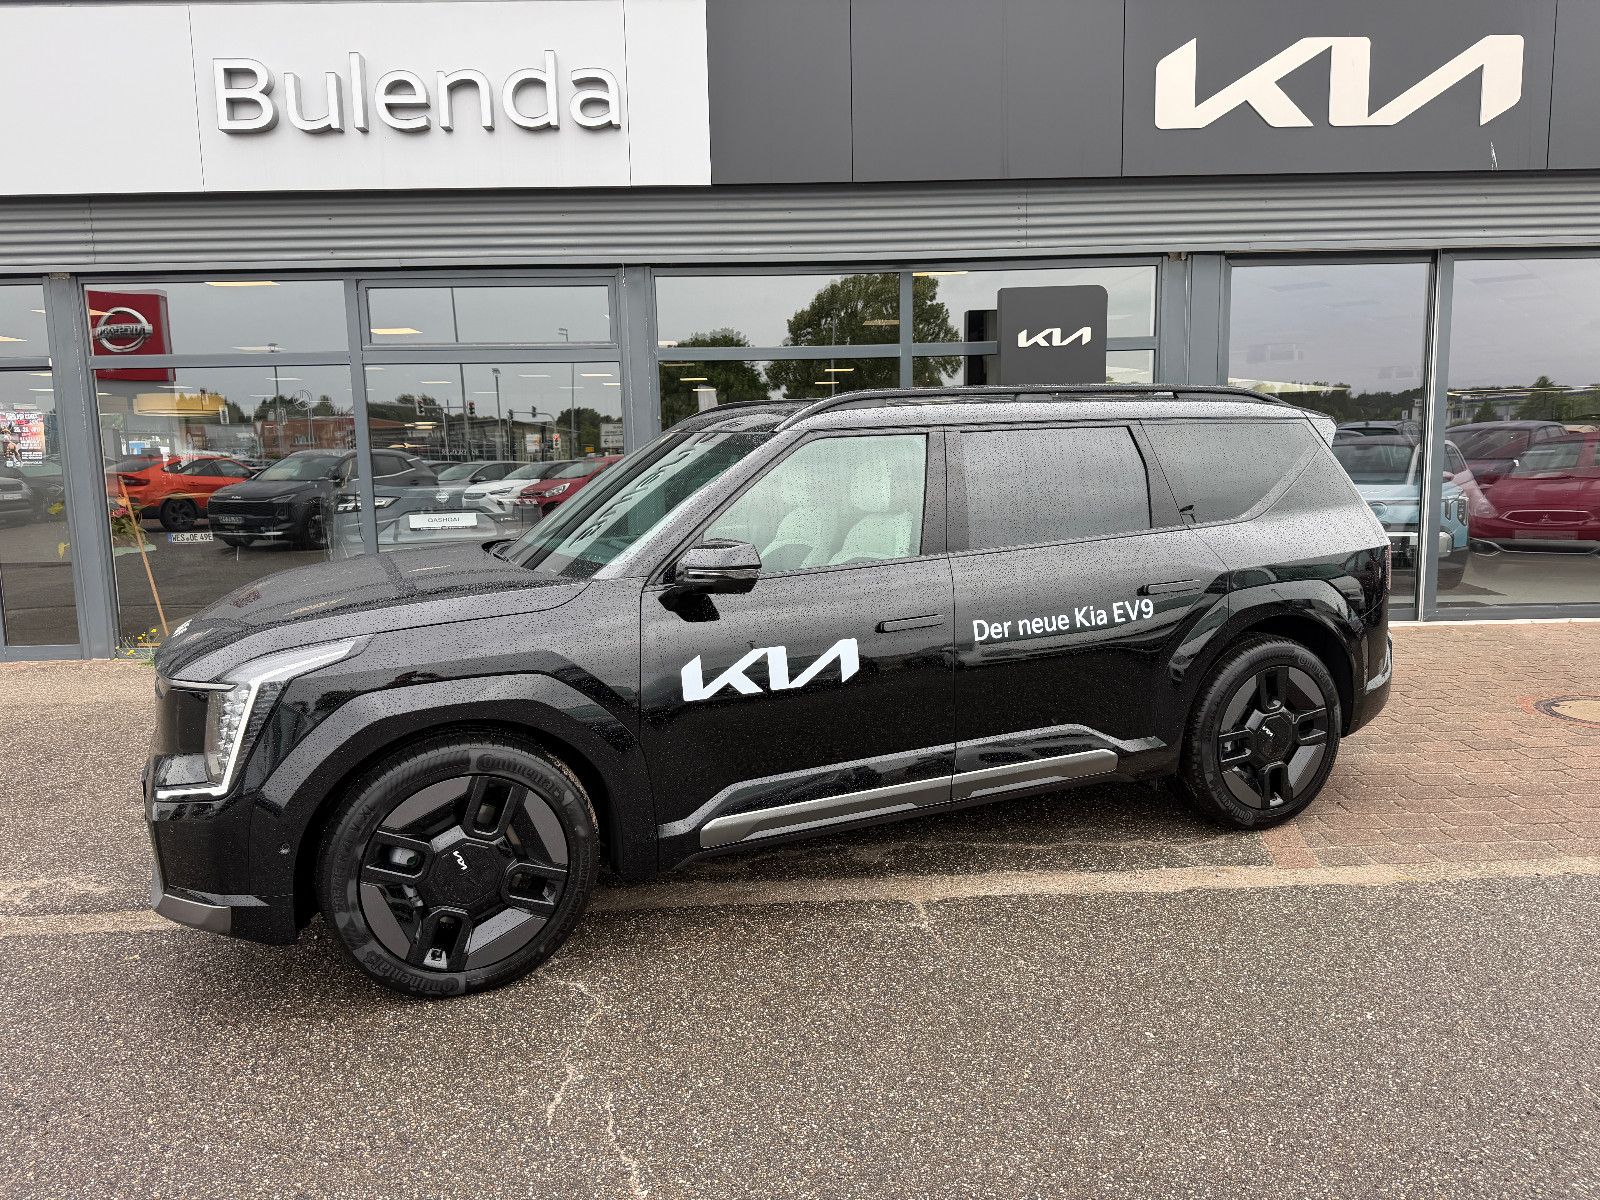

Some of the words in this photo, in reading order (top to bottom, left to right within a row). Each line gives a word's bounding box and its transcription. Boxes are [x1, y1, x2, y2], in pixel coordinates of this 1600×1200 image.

[212, 50, 621, 135] Bulenda
[1155, 34, 1525, 129] KIA
[1017, 326, 1092, 348] KIA
[972, 619, 1010, 642] Der
[1018, 613, 1070, 636] neue
[1074, 605, 1108, 628] Kia
[1112, 598, 1154, 623] EV9
[681, 638, 860, 702] KIA
